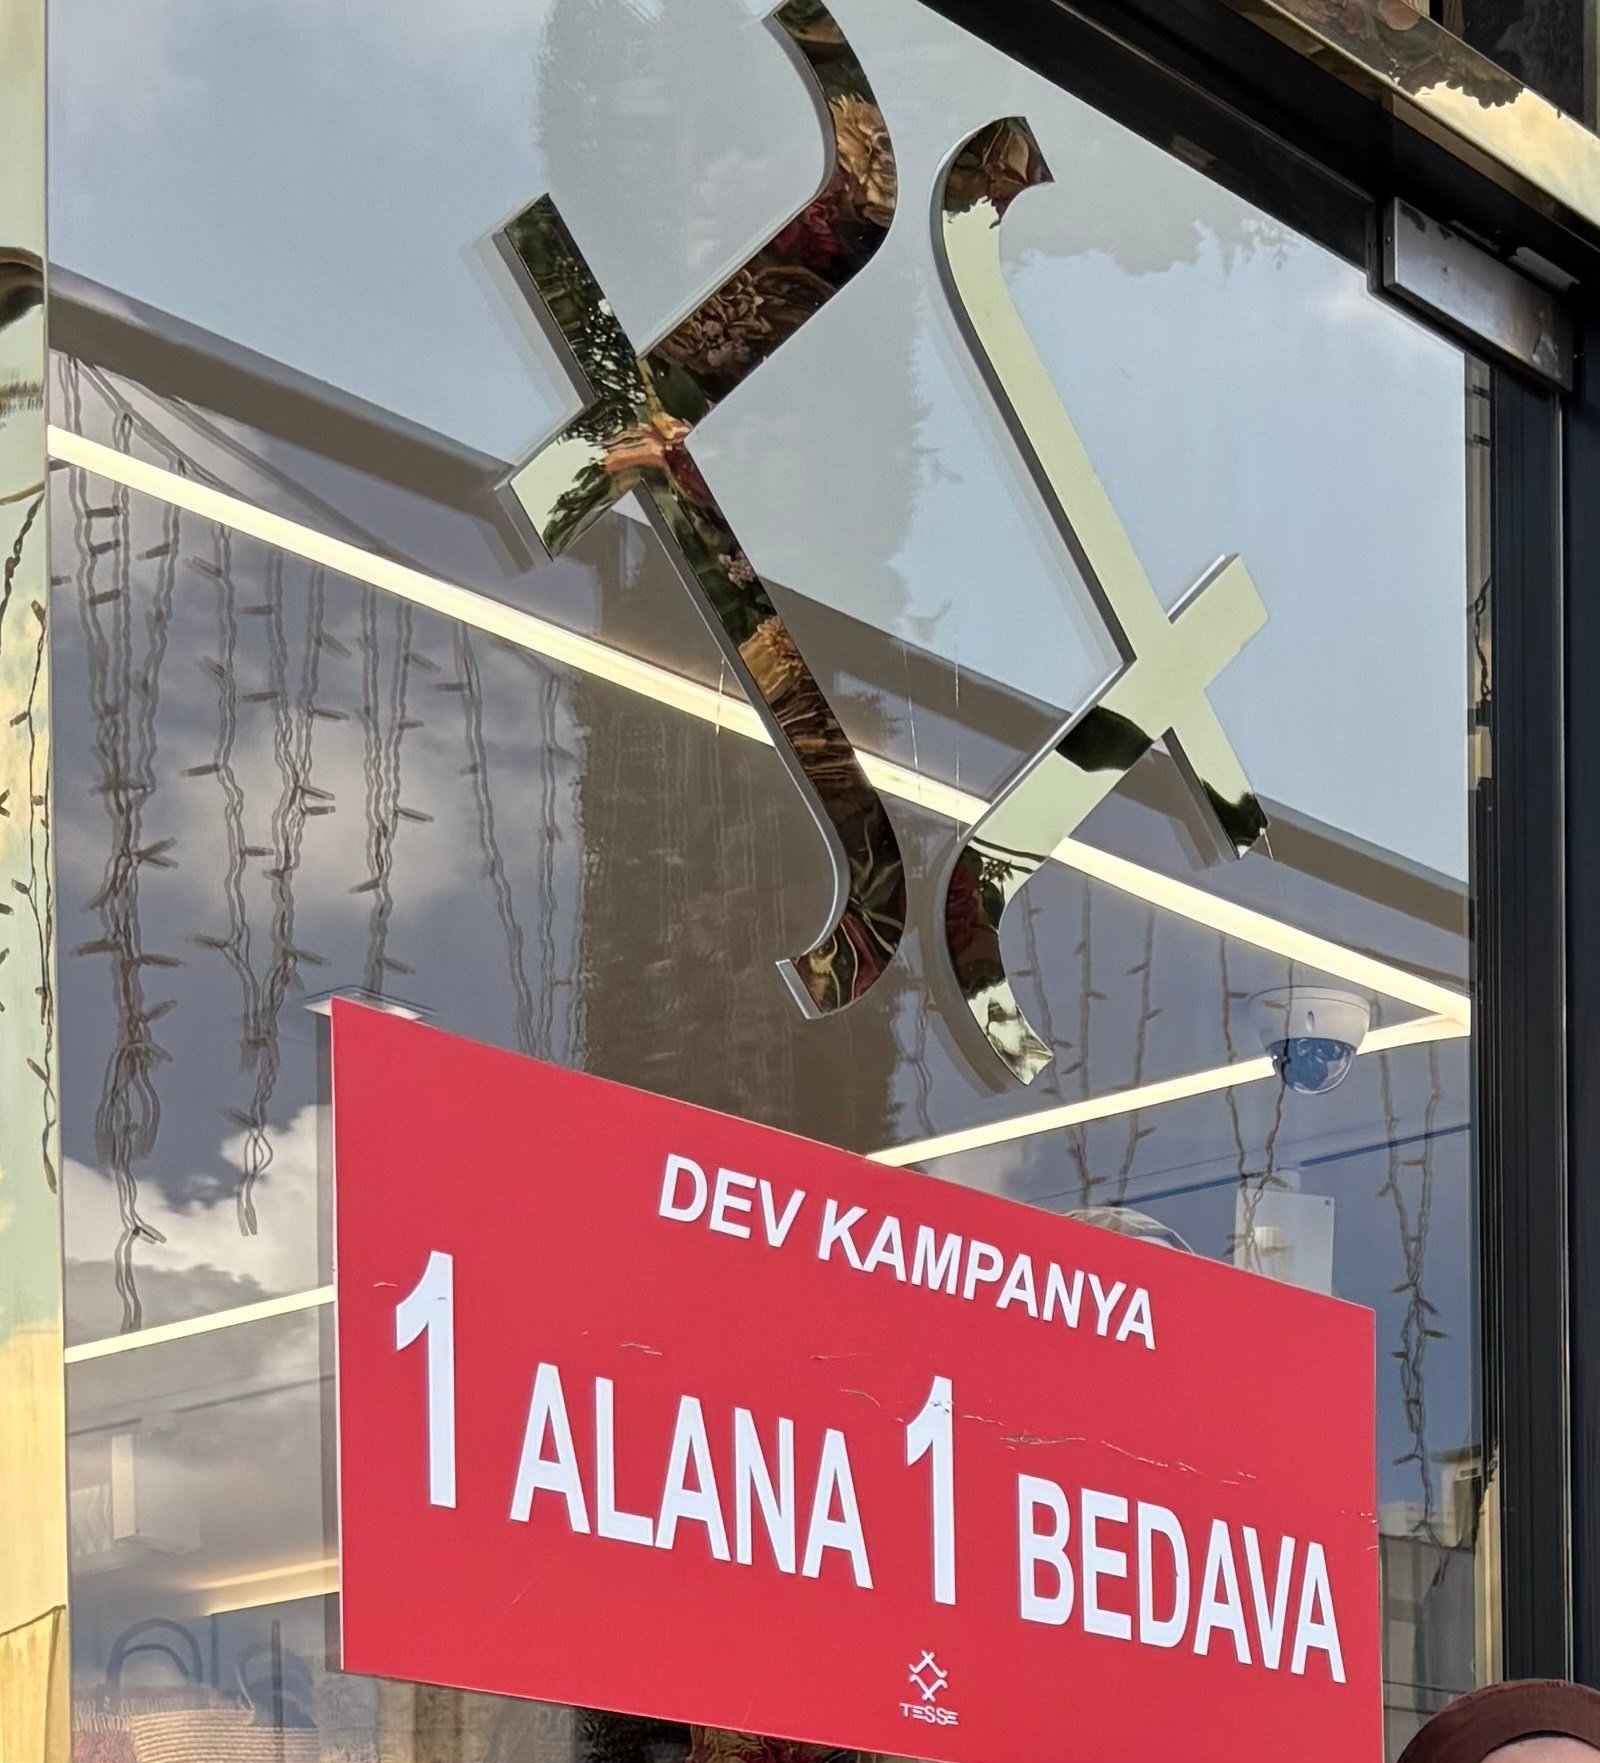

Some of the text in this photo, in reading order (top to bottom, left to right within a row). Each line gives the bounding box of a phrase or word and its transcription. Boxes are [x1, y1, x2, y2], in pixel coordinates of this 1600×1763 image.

[658, 1153, 1156, 1350] DEV KAMPANYA
[395, 1250, 1347, 1684] 1 ALANA 1 BEDAVA
[899, 1702, 959, 1726] TESSE
